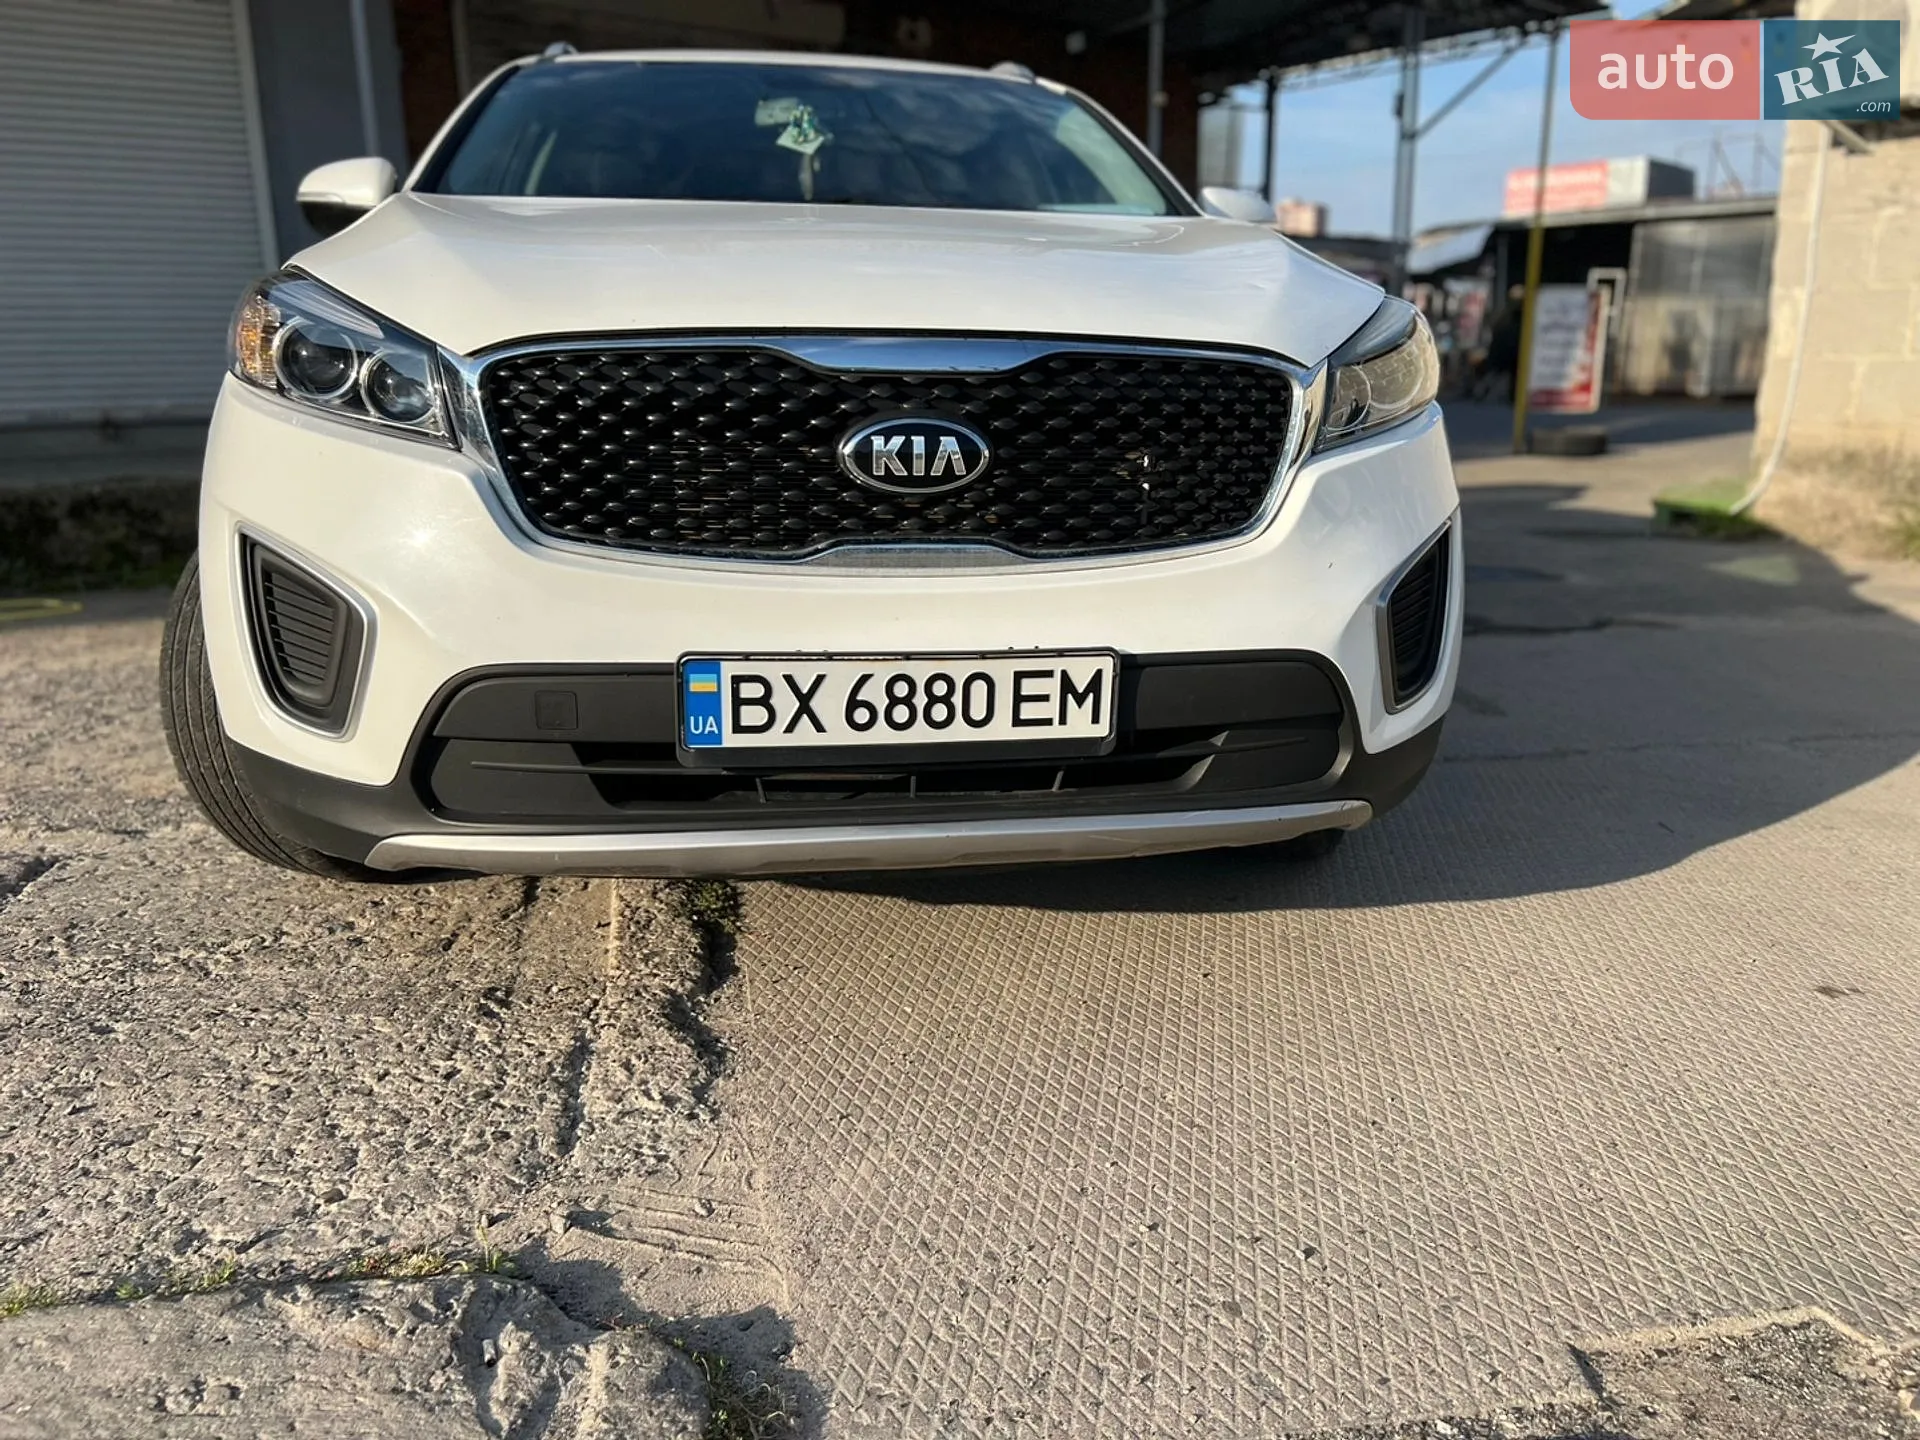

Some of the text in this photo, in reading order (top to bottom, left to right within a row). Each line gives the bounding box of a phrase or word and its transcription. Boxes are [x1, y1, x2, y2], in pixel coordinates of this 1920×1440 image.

[870, 435, 967, 476] KIA
[730, 668, 1104, 735] BX 6880 EM
[689, 715, 719, 735] UA
